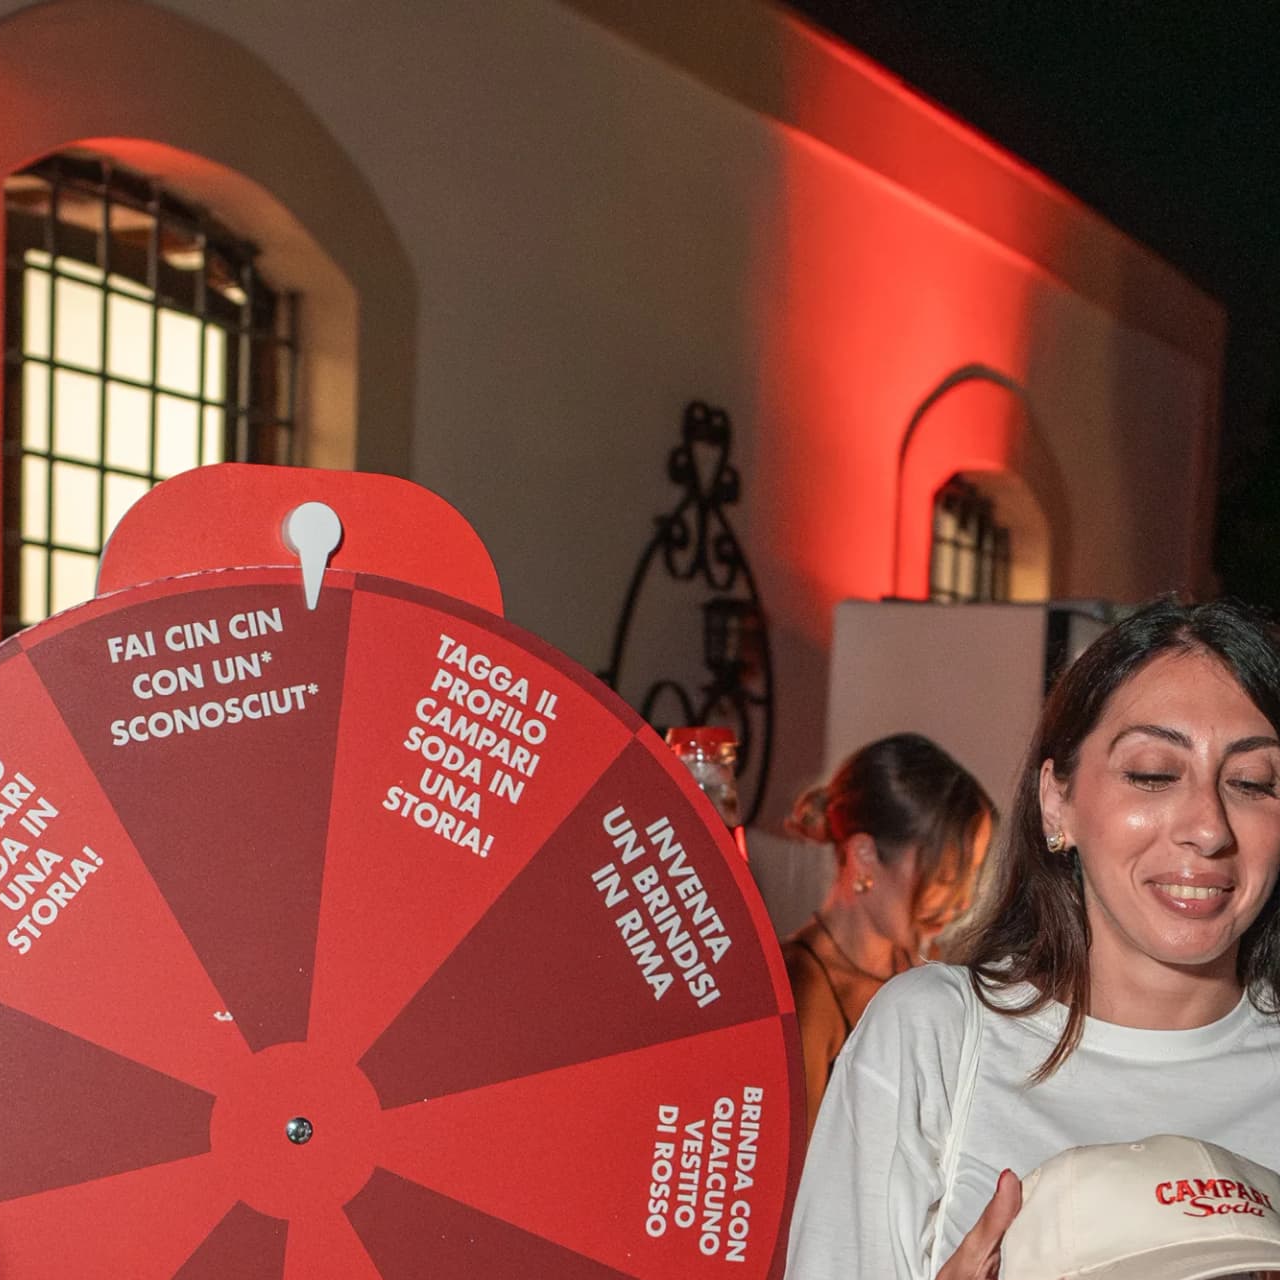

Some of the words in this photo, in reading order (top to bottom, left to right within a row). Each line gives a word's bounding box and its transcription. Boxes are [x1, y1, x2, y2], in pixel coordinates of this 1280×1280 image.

[107, 631, 156, 663] FAI
[165, 619, 220, 652] CIN
[229, 608, 283, 639] CIN
[132, 663, 204, 699] CON
[432, 669, 546, 744] PROFILO
[438, 635, 528, 704] TAGGA
[536, 691, 557, 719] IL
[404, 727, 481, 784] SODA
[489, 770, 524, 803] IN
[416, 698, 539, 776] CAMPARI
[20, 797, 58, 837] IN
[383, 787, 493, 857] STORIA!
[420, 768, 480, 818] UNA
[7, 846, 103, 954] STORIA!
[603, 806, 645, 864] UN
[632, 865, 720, 1007] BRINDISI
[646, 817, 731, 963] INVENTA
[592, 863, 629, 908] IN
[616, 909, 674, 1000] RIMA
[658, 1106, 679, 1132] DI
[734, 1087, 762, 1190] BRINDA
[646, 1143, 674, 1236] ROSSO
[675, 1120, 704, 1227] VESTITO
[700, 1098, 734, 1255] QUALCUNO
[1155, 1178, 1272, 1209] CAMPARI
[1183, 1196, 1265, 1217] Soda
[726, 1201, 750, 1261] CON
